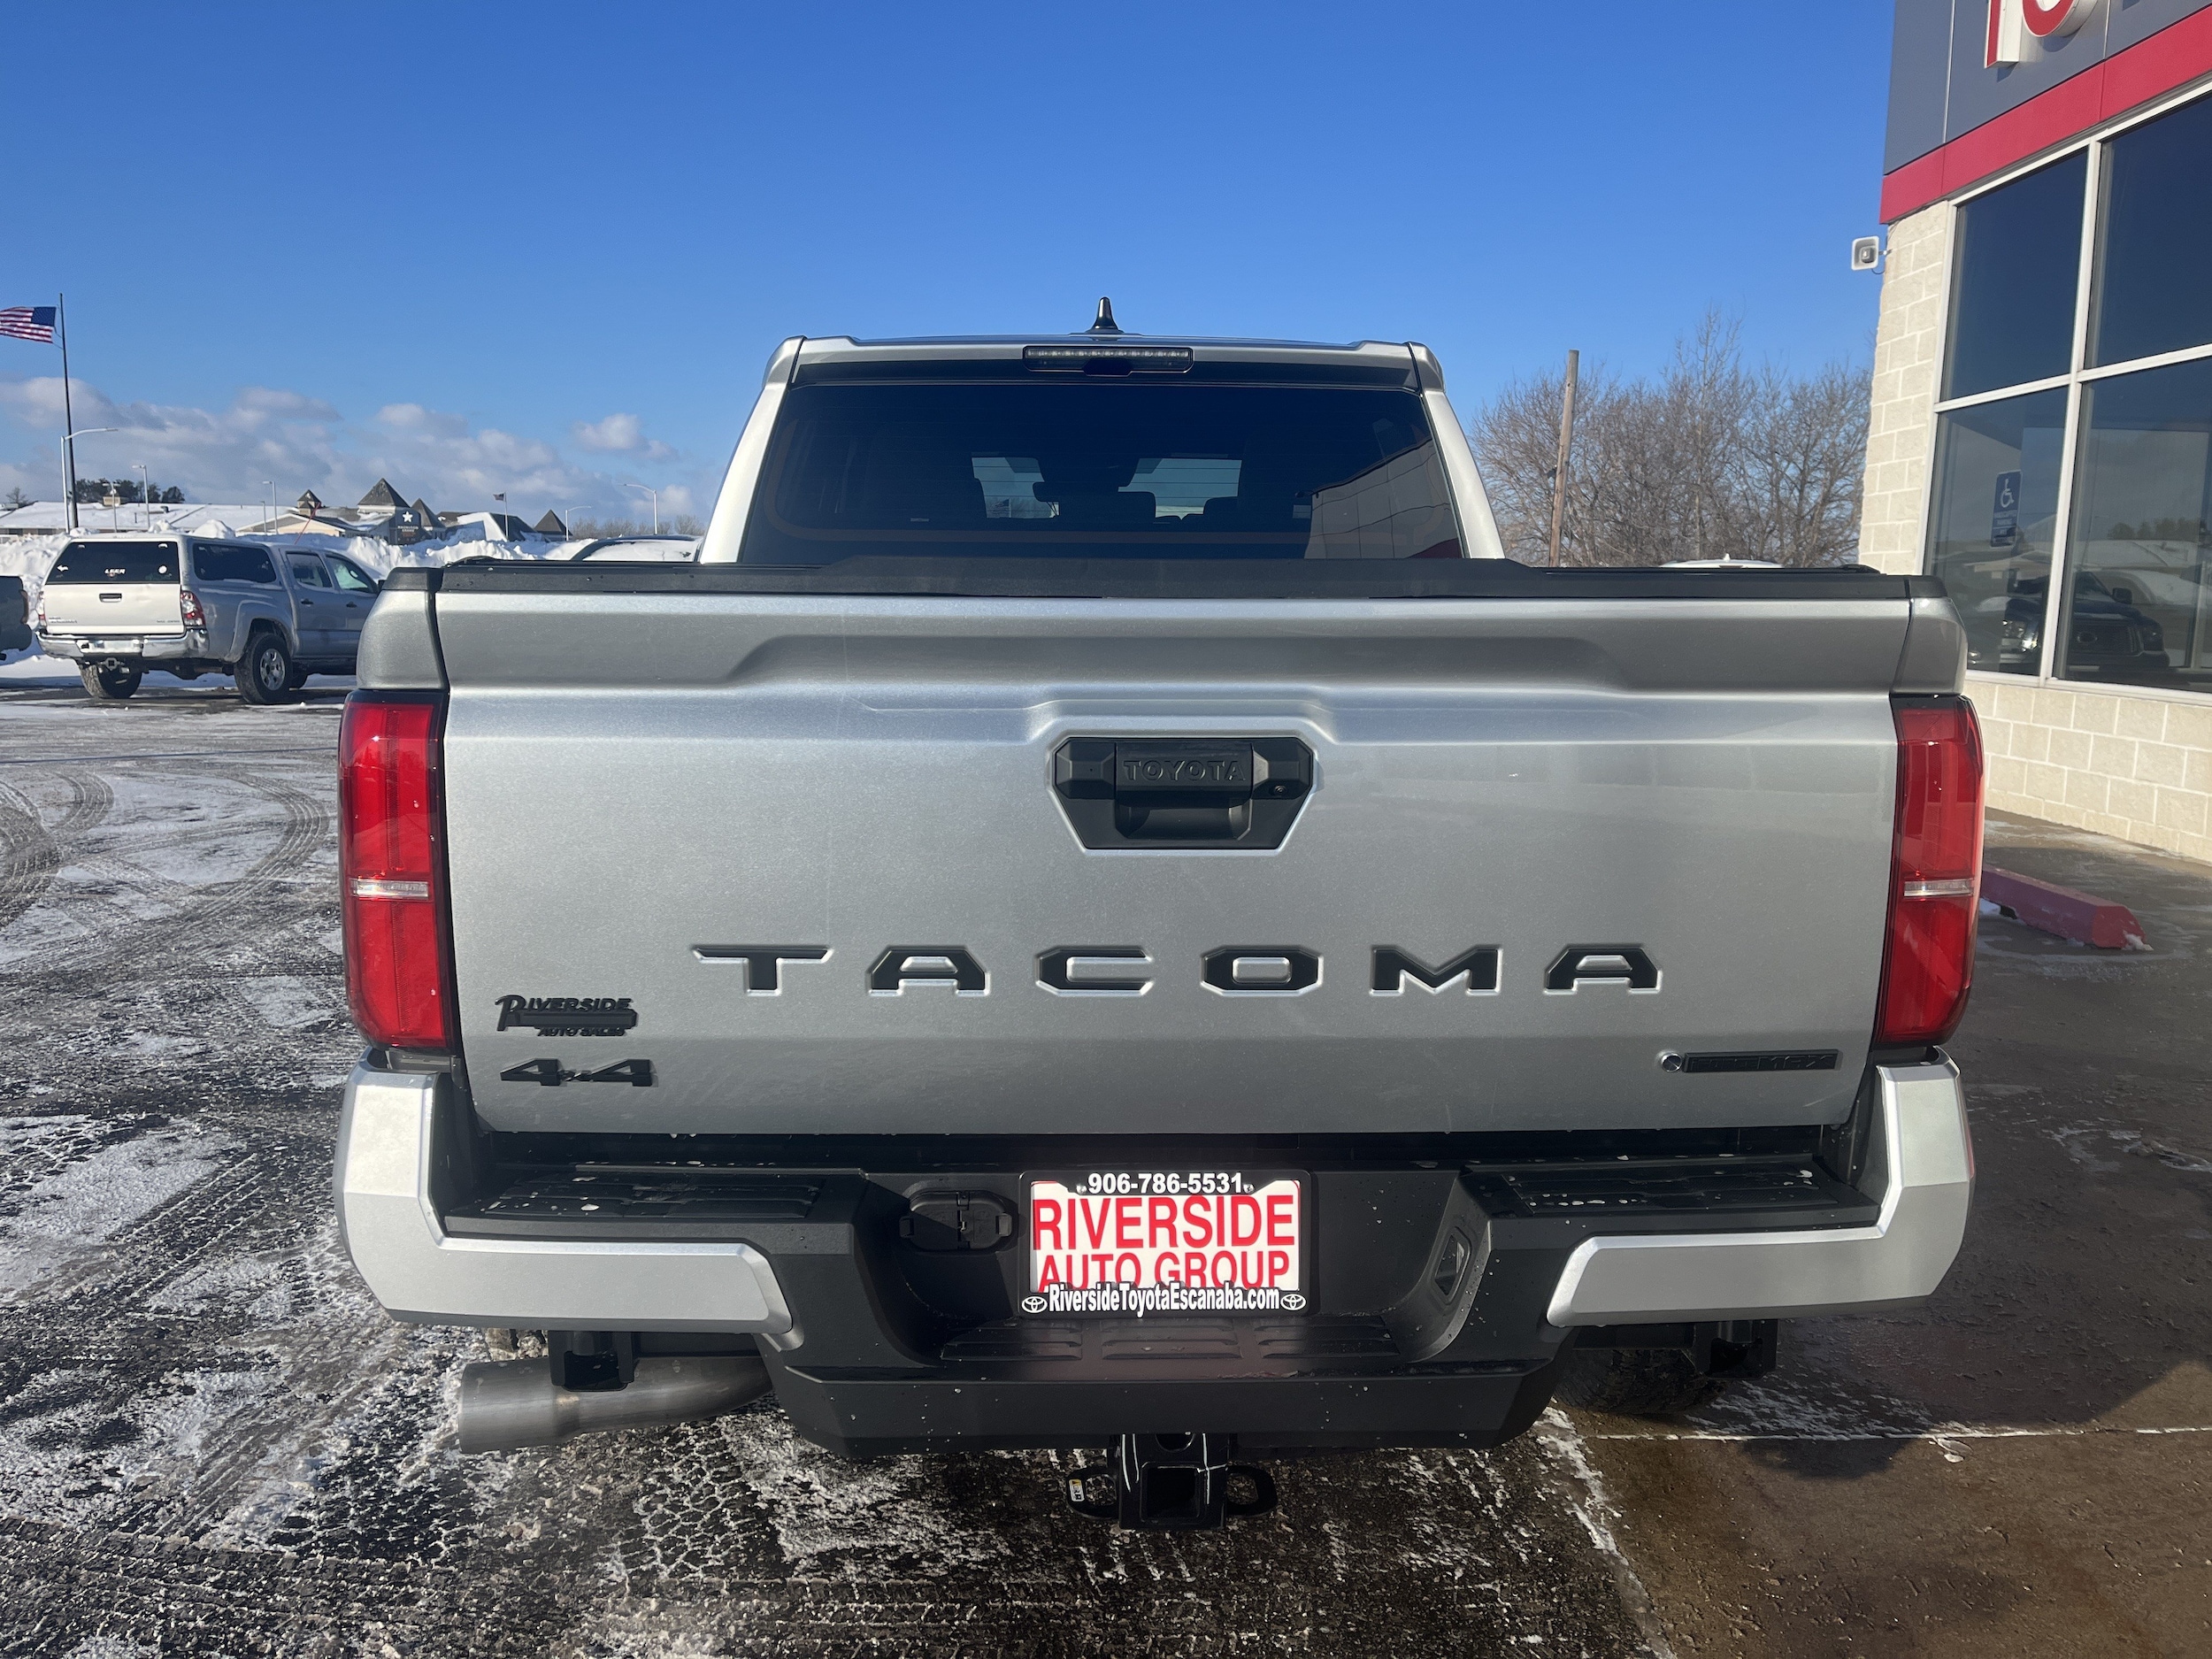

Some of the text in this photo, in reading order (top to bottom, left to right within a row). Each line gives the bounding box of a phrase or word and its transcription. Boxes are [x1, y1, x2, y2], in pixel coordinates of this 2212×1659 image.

[1123, 760, 1246, 780] TOYOTA
[691, 946, 1662, 996] TACOMA
[495, 995, 633, 1031] RIVERSIDE
[1088, 1172, 1241, 1194] 906-786-5531
[1033, 1195, 1294, 1250] RIVERSIDE
[1039, 1250, 1290, 1293] AUTO GROUP
[1049, 1282, 1279, 1317] RiversideToyotaEscanaba.com
